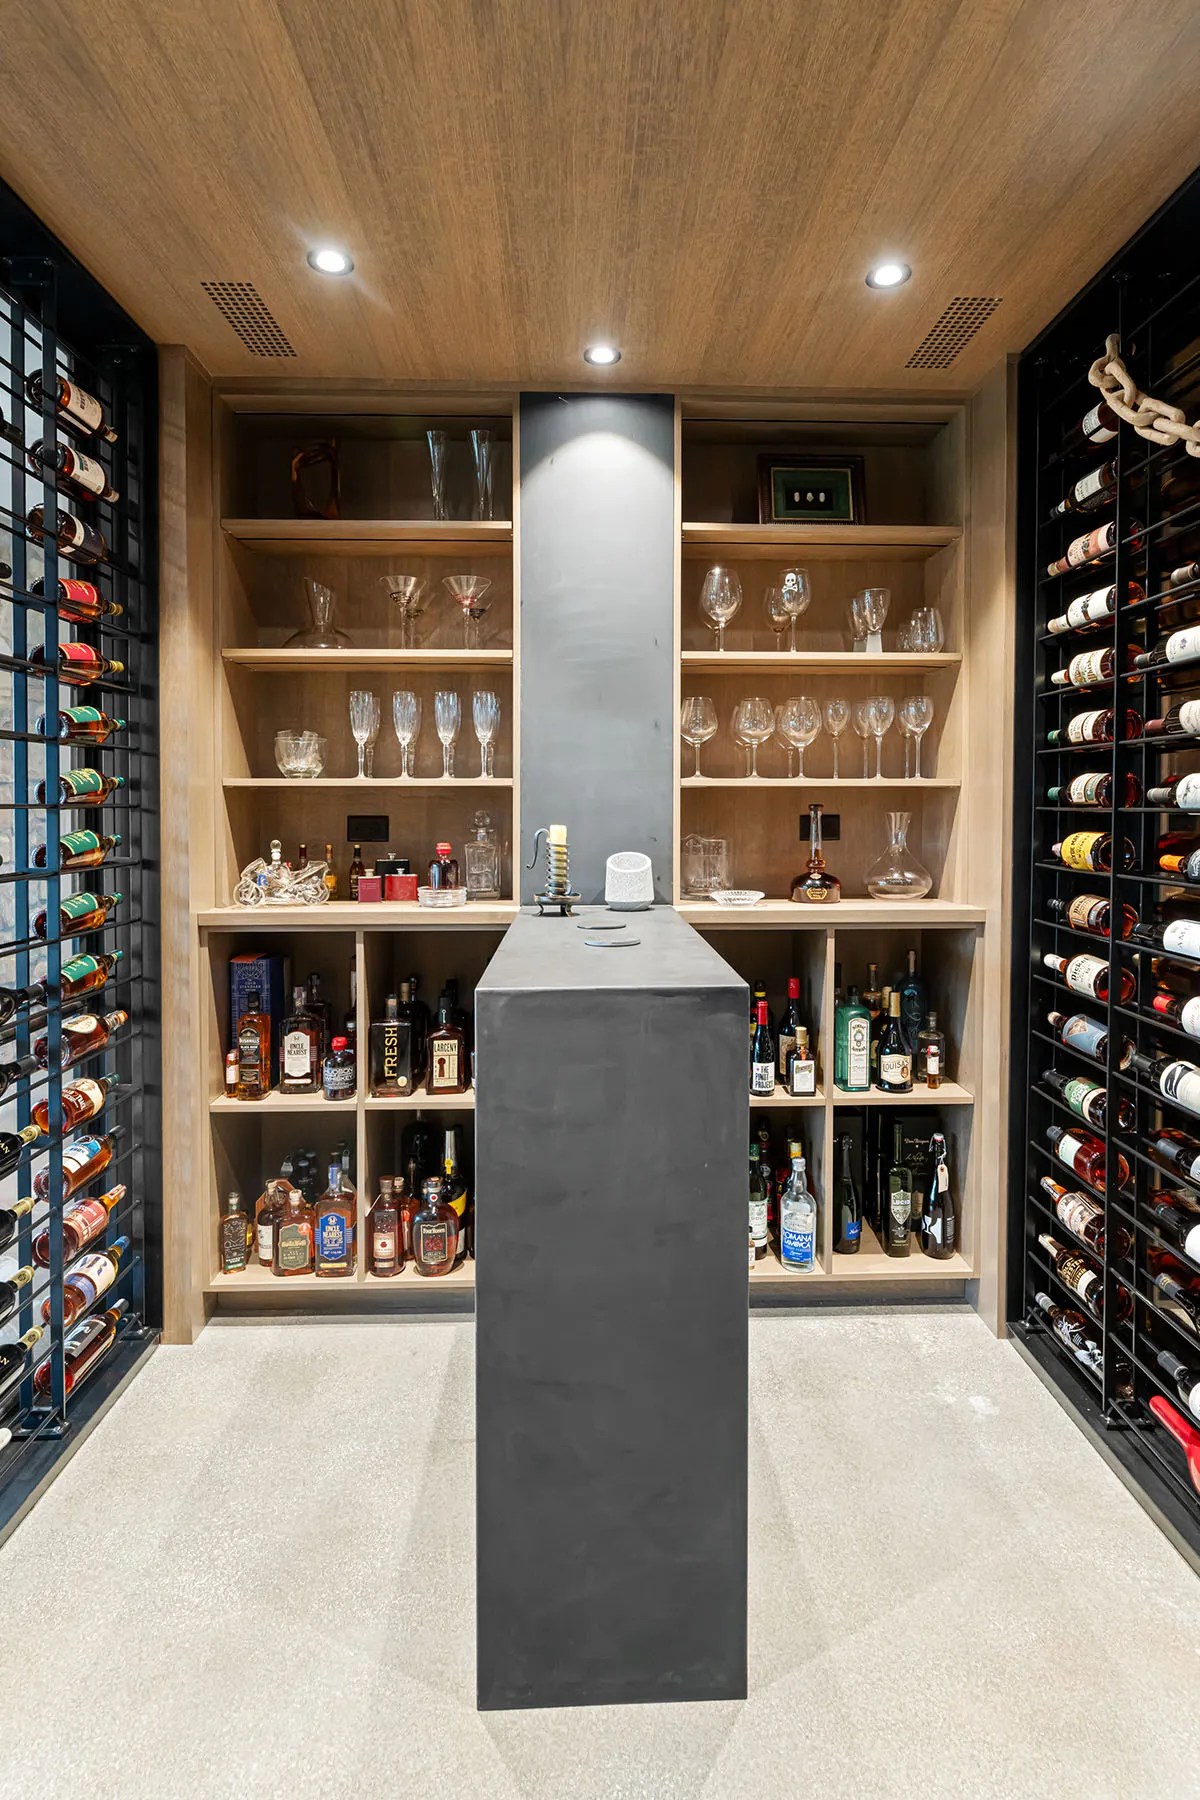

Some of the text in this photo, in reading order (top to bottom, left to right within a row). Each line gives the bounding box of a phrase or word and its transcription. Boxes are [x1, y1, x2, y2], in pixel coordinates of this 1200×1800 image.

[384, 1026, 398, 1077] FRESH
[434, 1043, 457, 1052] LARCENY
[755, 1073, 769, 1081] PINOT
[755, 1080, 774, 1089] PROJECT
